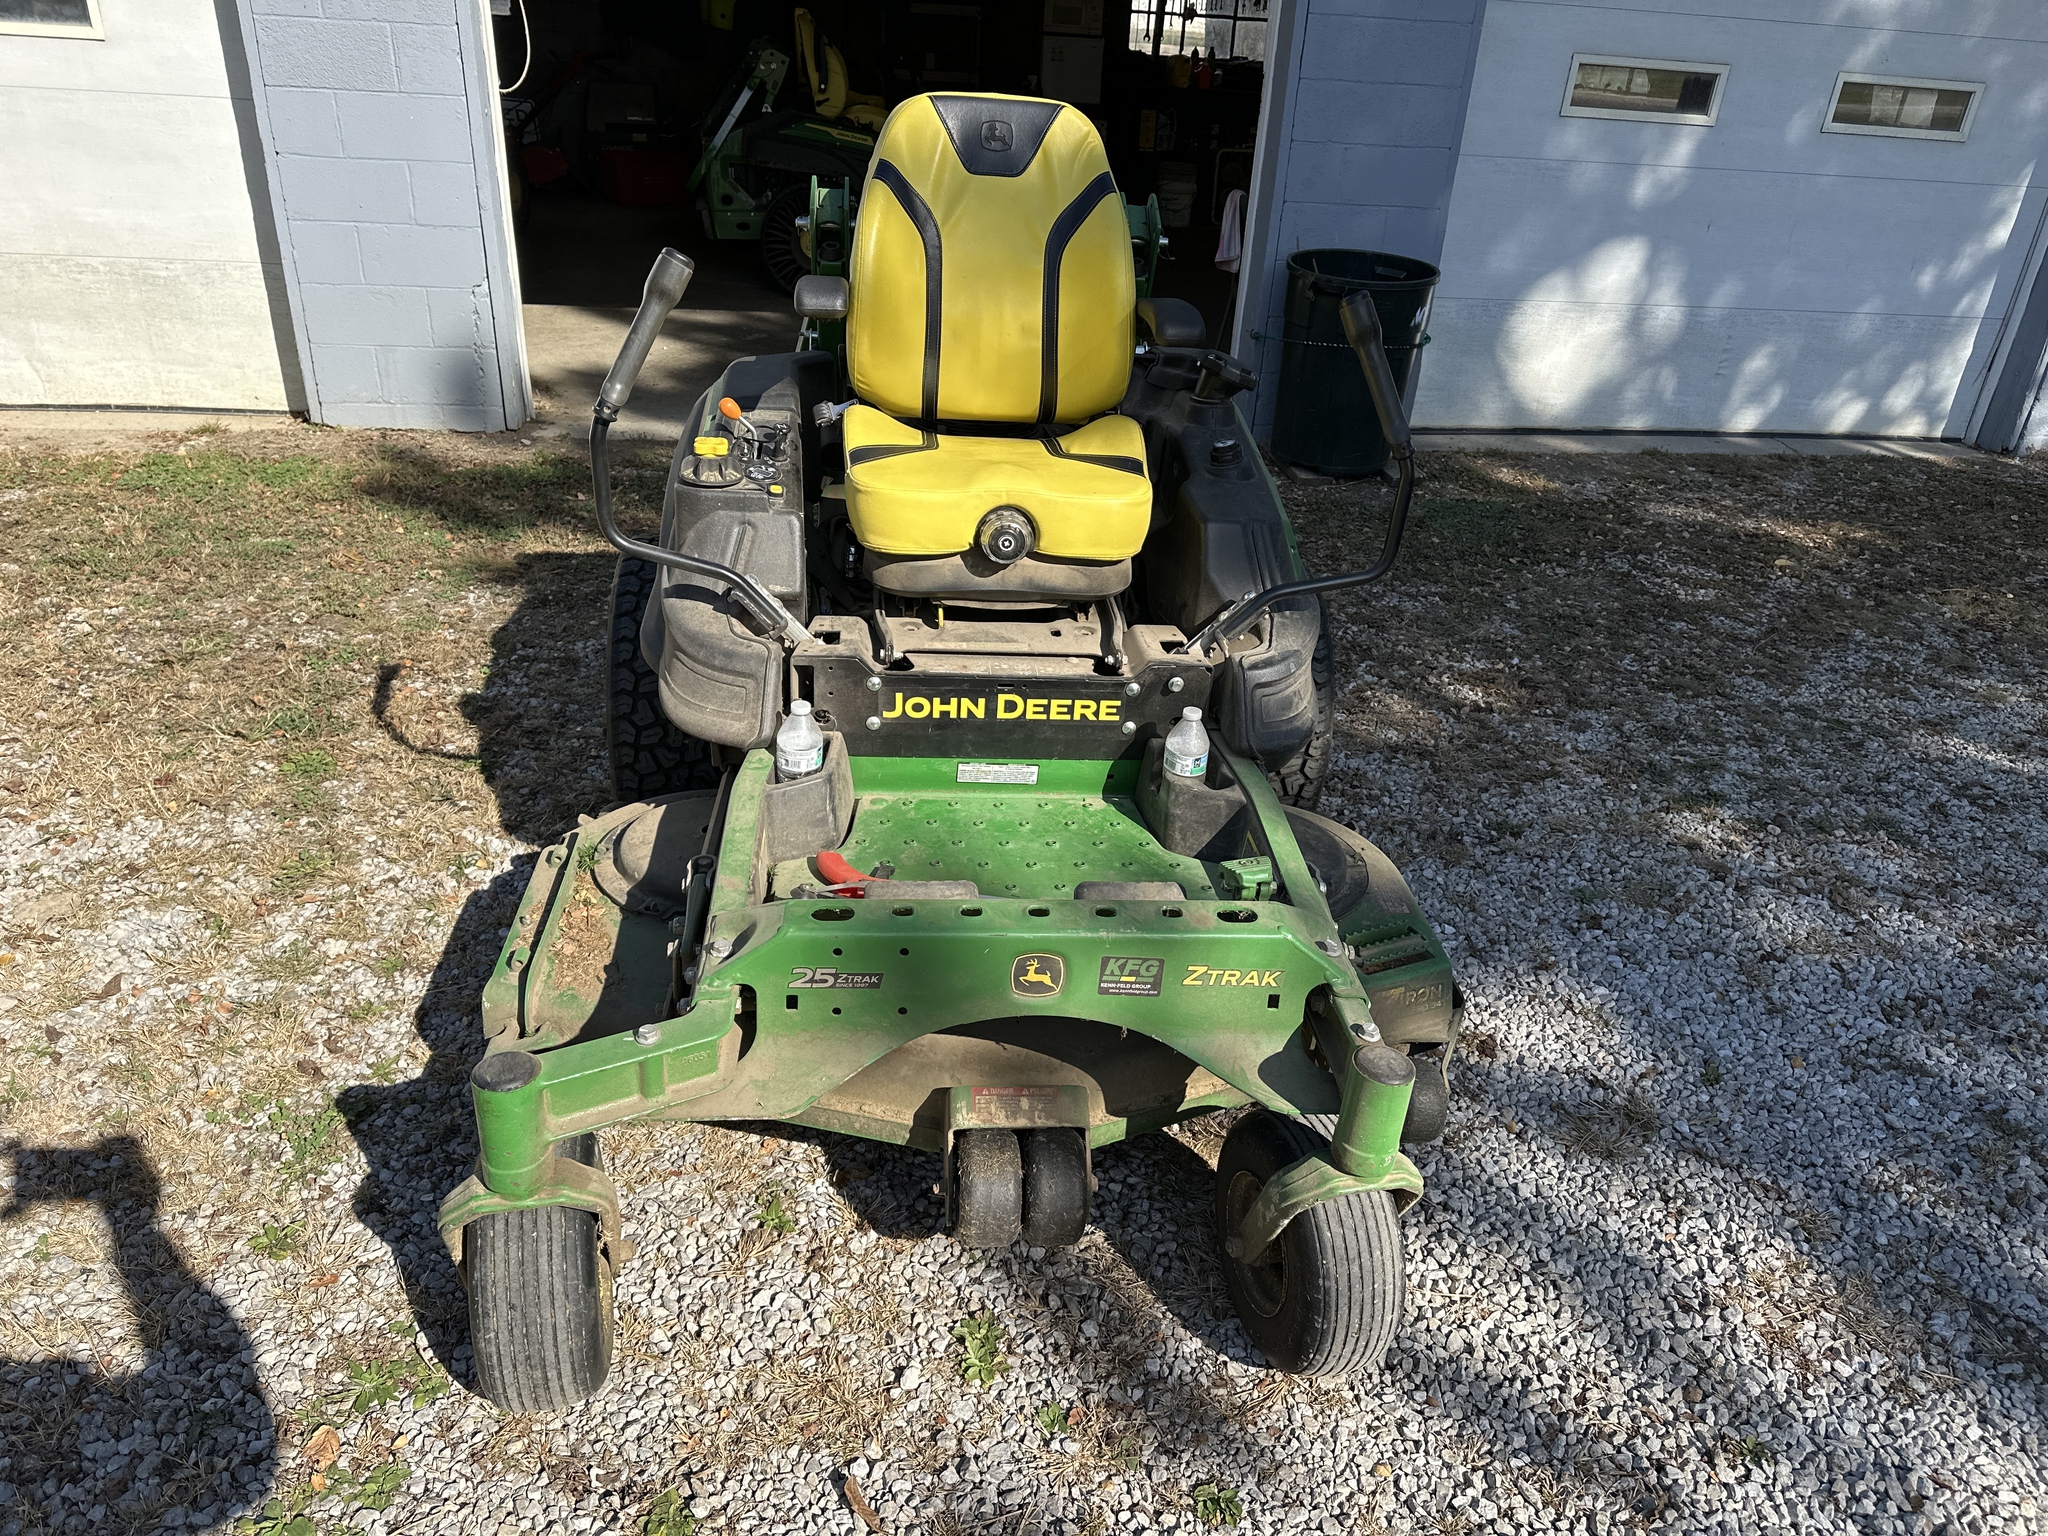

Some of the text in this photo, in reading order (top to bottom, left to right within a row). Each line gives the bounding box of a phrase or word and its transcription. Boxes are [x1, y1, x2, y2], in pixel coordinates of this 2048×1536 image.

[882, 692, 1122, 721] JOHN DEERE
[1104, 958, 1160, 977] KFG
[1182, 965, 1284, 988] ZTRAK
[787, 967, 880, 989] 25 ZTRAK
[990, 1087, 1014, 1095] DANGER
[1029, 1087, 1055, 1096] PELIGRO
